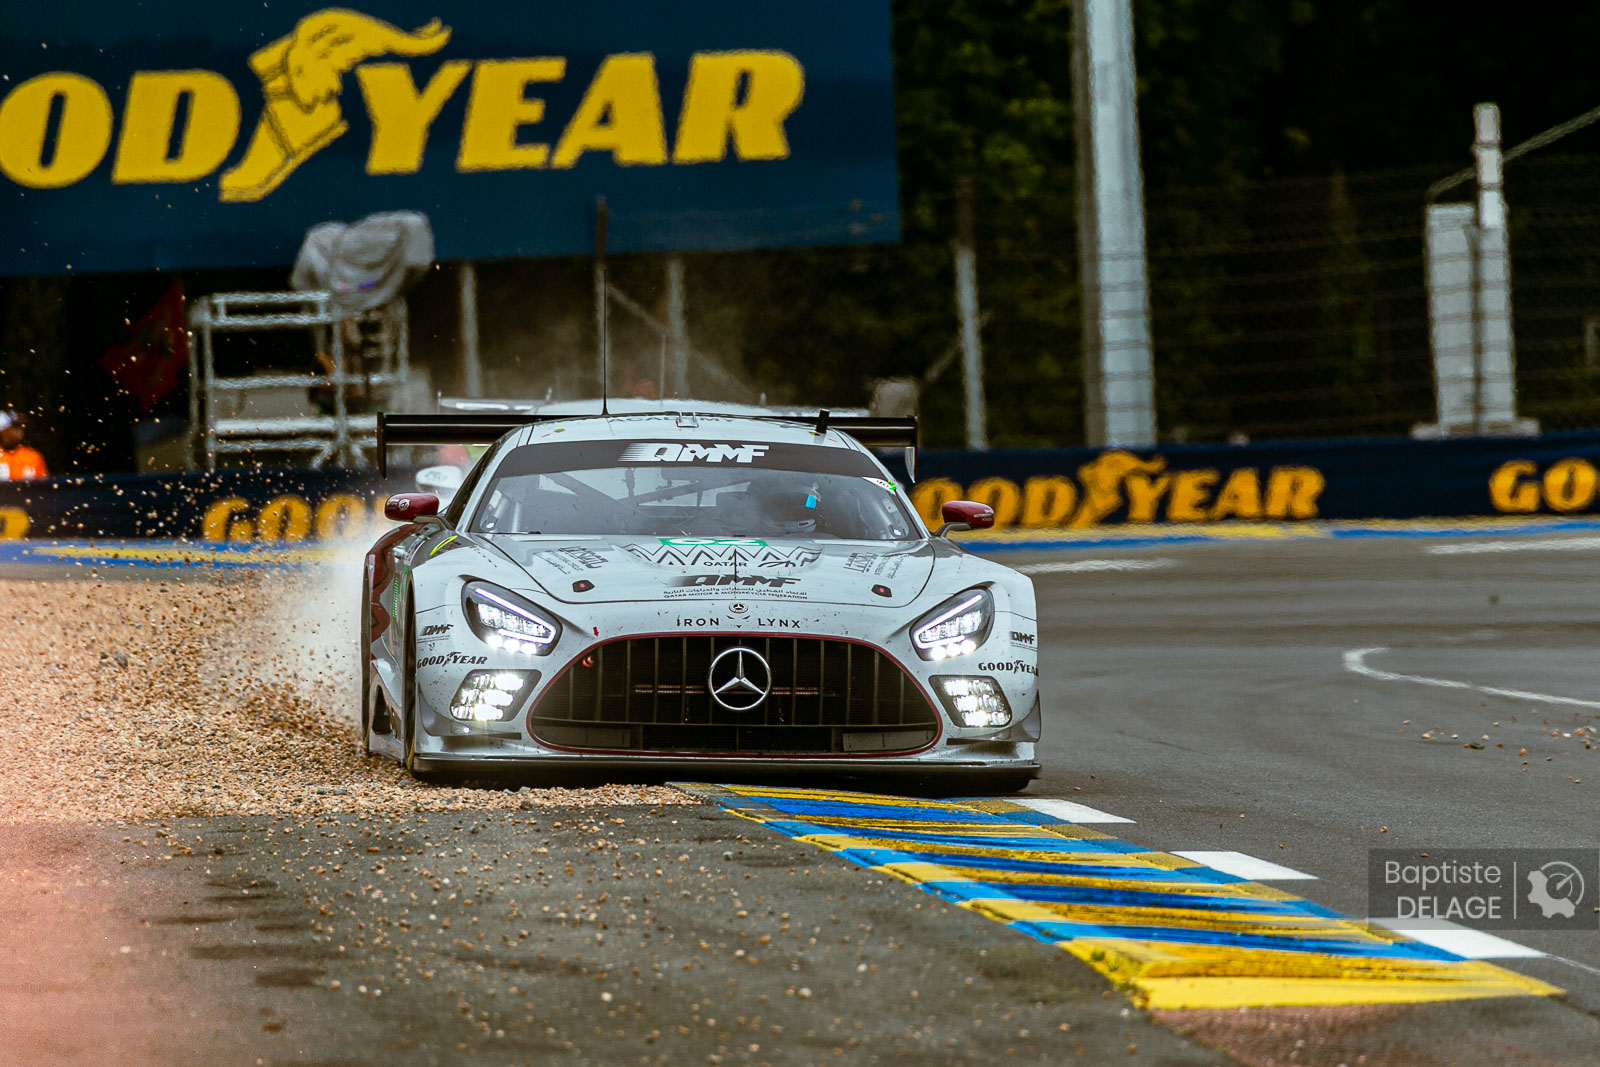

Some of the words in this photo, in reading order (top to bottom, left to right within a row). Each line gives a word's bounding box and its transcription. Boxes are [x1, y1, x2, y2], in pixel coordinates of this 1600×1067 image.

[618, 442, 769, 462] QMMF
[676, 617, 720, 627] IRON
[758, 617, 801, 629] LYNX
